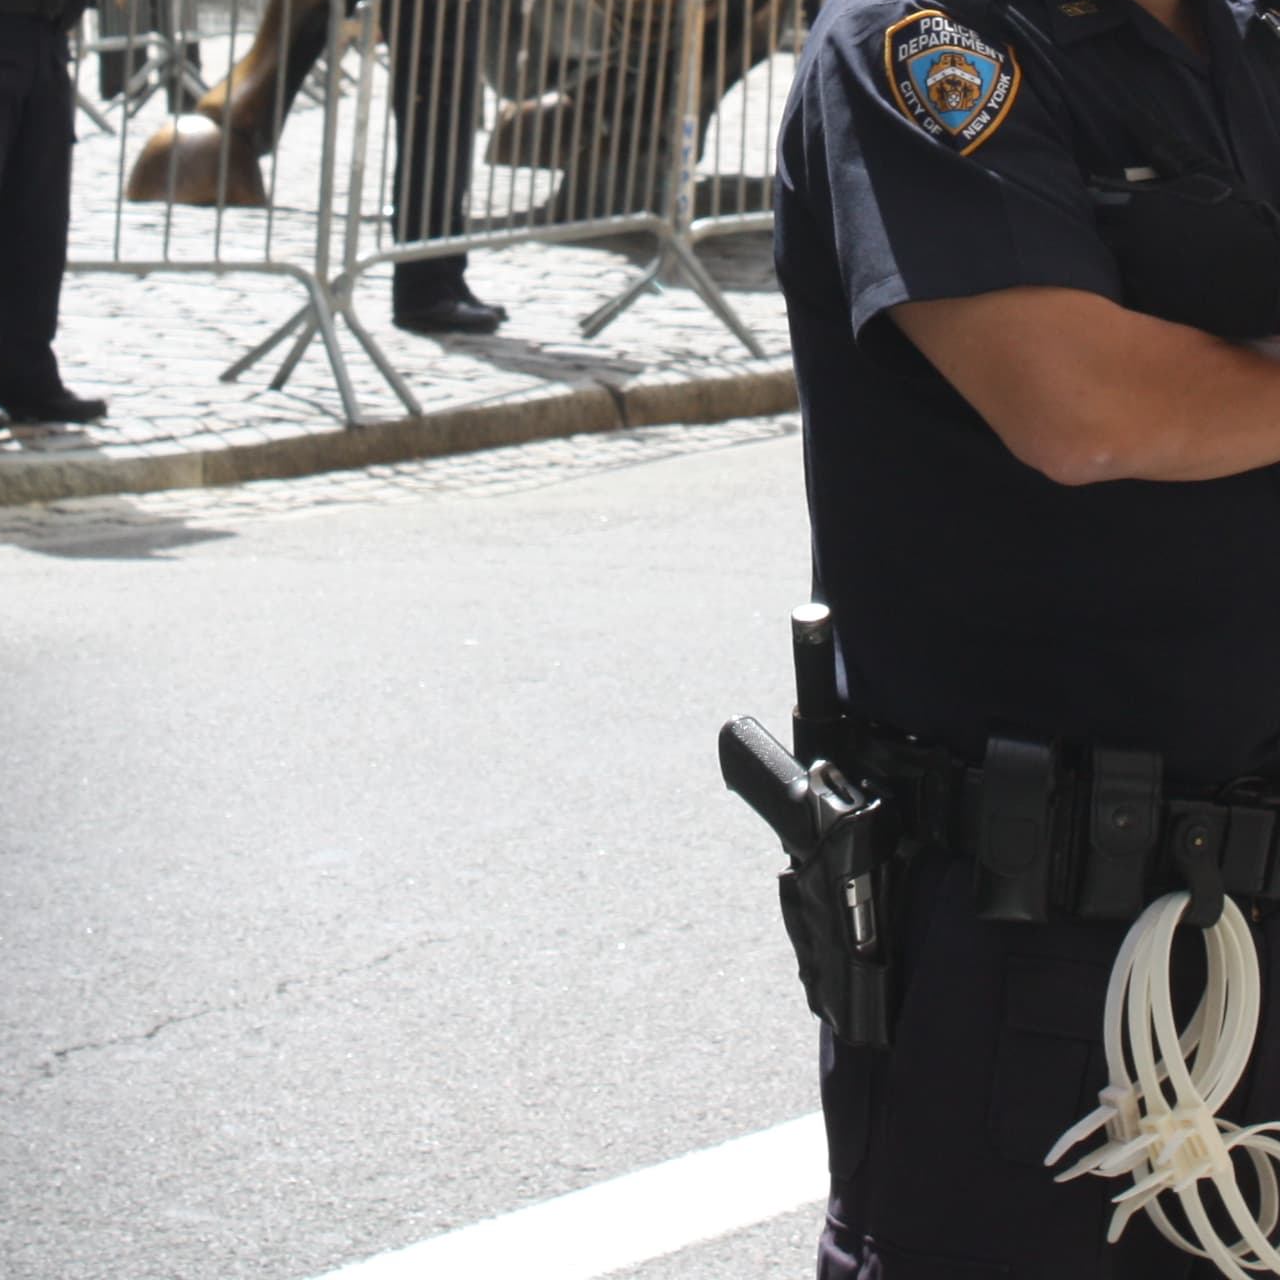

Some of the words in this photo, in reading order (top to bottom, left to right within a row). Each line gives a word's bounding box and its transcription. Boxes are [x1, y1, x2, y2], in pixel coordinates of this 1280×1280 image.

[898, 30, 1005, 63] DEPARTMENT
[920, 16, 980, 41] POLICE
[900, 79, 926, 116] CITY
[923, 116, 944, 136] OF
[962, 109, 991, 140] NEW
[987, 72, 1012, 110] YORK
